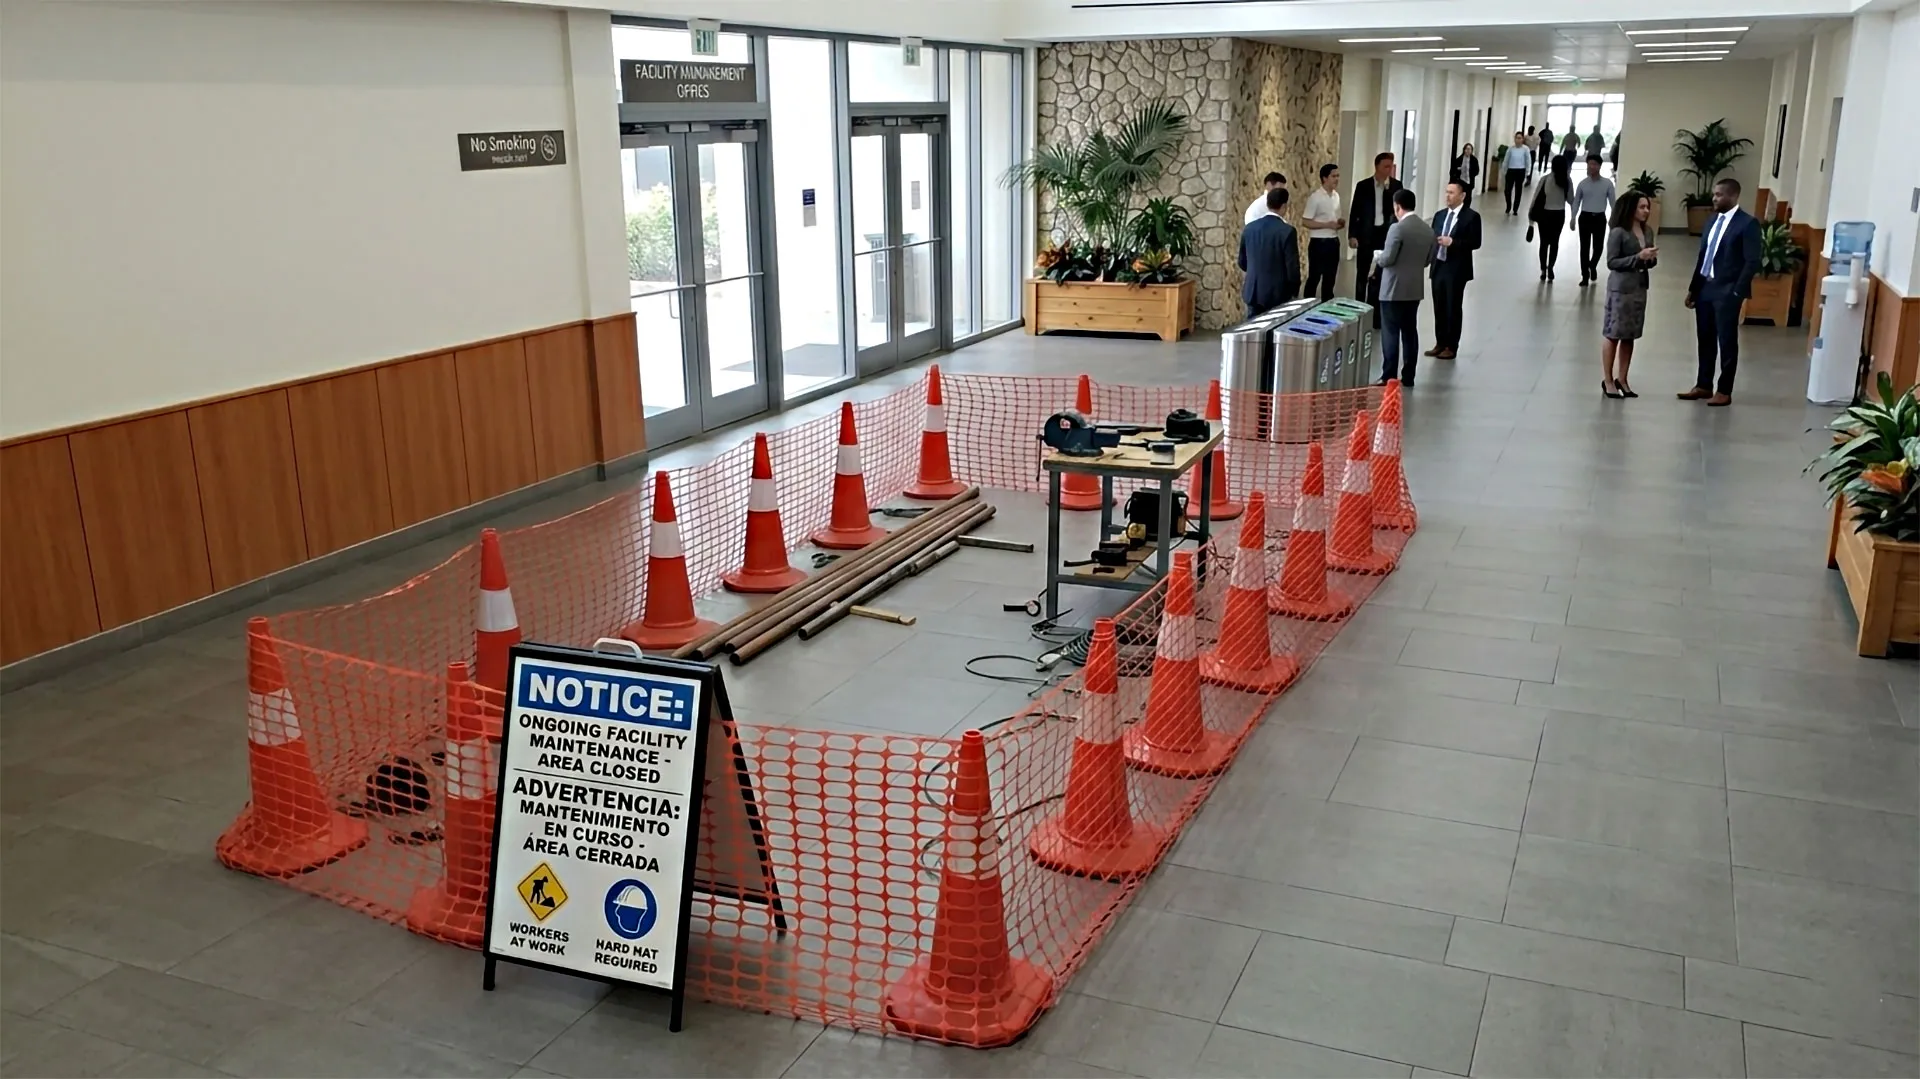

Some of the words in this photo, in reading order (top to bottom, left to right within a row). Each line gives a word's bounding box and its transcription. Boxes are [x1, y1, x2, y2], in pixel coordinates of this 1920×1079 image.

[470, 137, 487, 152] No
[489, 134, 536, 155] Smoking
[528, 672, 684, 722] NOTICE:
[519, 713, 601, 738] ONGOING
[607, 726, 688, 750] FACILITY
[530, 733, 659, 765] MAINTENANCE
[537, 753, 584, 773] AREA
[590, 761, 661, 784] CLOSED
[512, 776, 681, 820] ADVERTENCIA:
[520, 799, 670, 837] MANTENIMIENTO
[544, 822, 567, 840] EN
[573, 827, 634, 849] CURSO
[522, 832, 570, 858] ÁREA
[575, 845, 660, 873] CERRADA
[510, 922, 570, 942] WORKERS
[510, 936, 526, 948] AT
[528, 939, 565, 956] WORK
[596, 938, 630, 954] HARD
